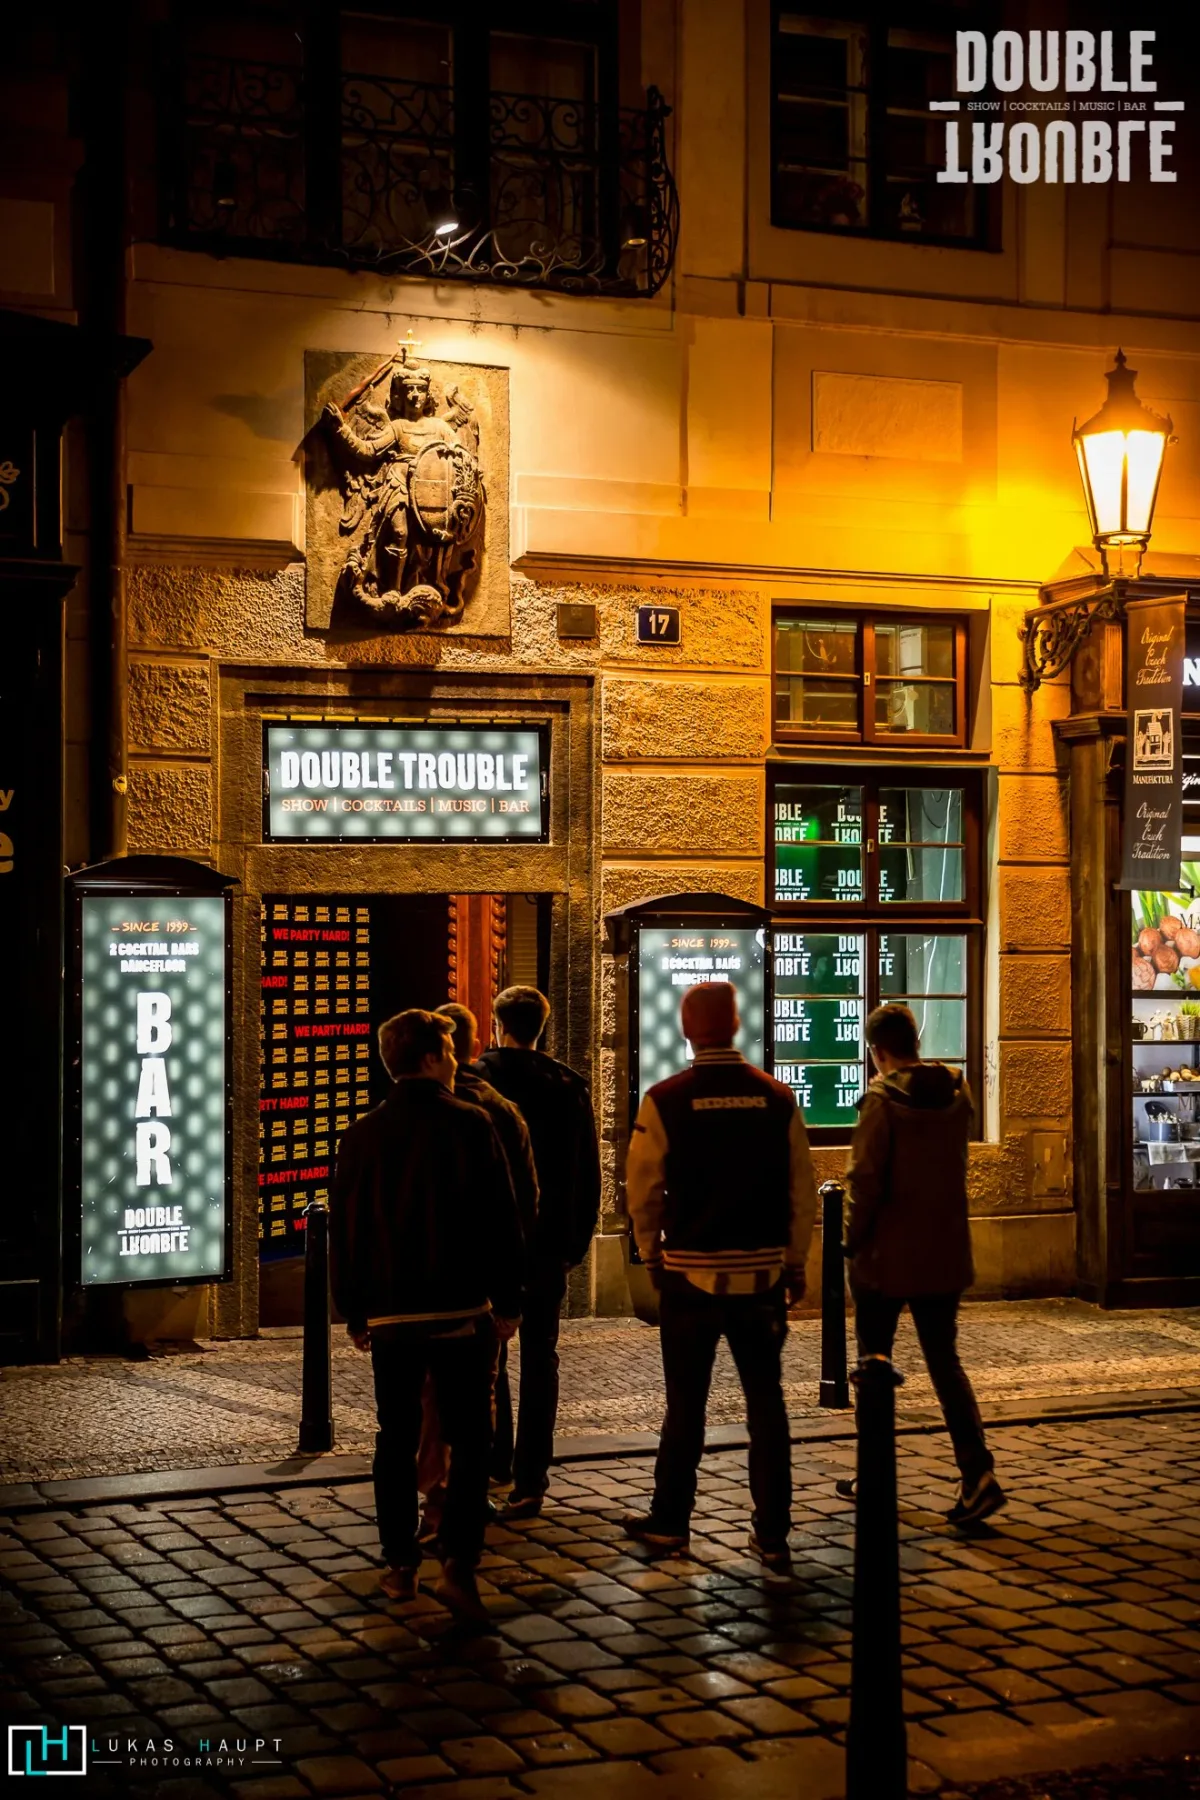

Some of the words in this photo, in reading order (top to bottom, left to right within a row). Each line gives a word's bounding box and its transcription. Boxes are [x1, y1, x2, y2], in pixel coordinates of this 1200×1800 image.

[649, 610, 670, 634] 17
[281, 751, 394, 788] DOUBLE
[399, 753, 529, 791] TROUBLE
[281, 799, 329, 812] SHOW
[341, 799, 426, 812] COCKTAILS
[438, 800, 487, 813] MUSIC
[498, 800, 530, 813] BAR
[122, 921, 160, 932] SINCE
[166, 921, 189, 933] 1999
[272, 928, 289, 940] WE
[290, 929, 320, 941] PARTY
[322, 930, 350, 942] HARD!
[118, 943, 169, 955] COCKTAIL
[171, 942, 200, 955] BARS
[671, 938, 704, 948] SINCE
[710, 938, 730, 948] 1999
[294, 1025, 311, 1038] WE
[312, 1024, 342, 1037] PARTY
[343, 1023, 370, 1035] HARD!
[134, 992, 173, 1187] BAR
[280, 1096, 309, 1109] HARD!
[267, 1169, 298, 1184] PARTY
[300, 1166, 329, 1180] HARD!
[125, 1206, 183, 1229] DOUBLE
